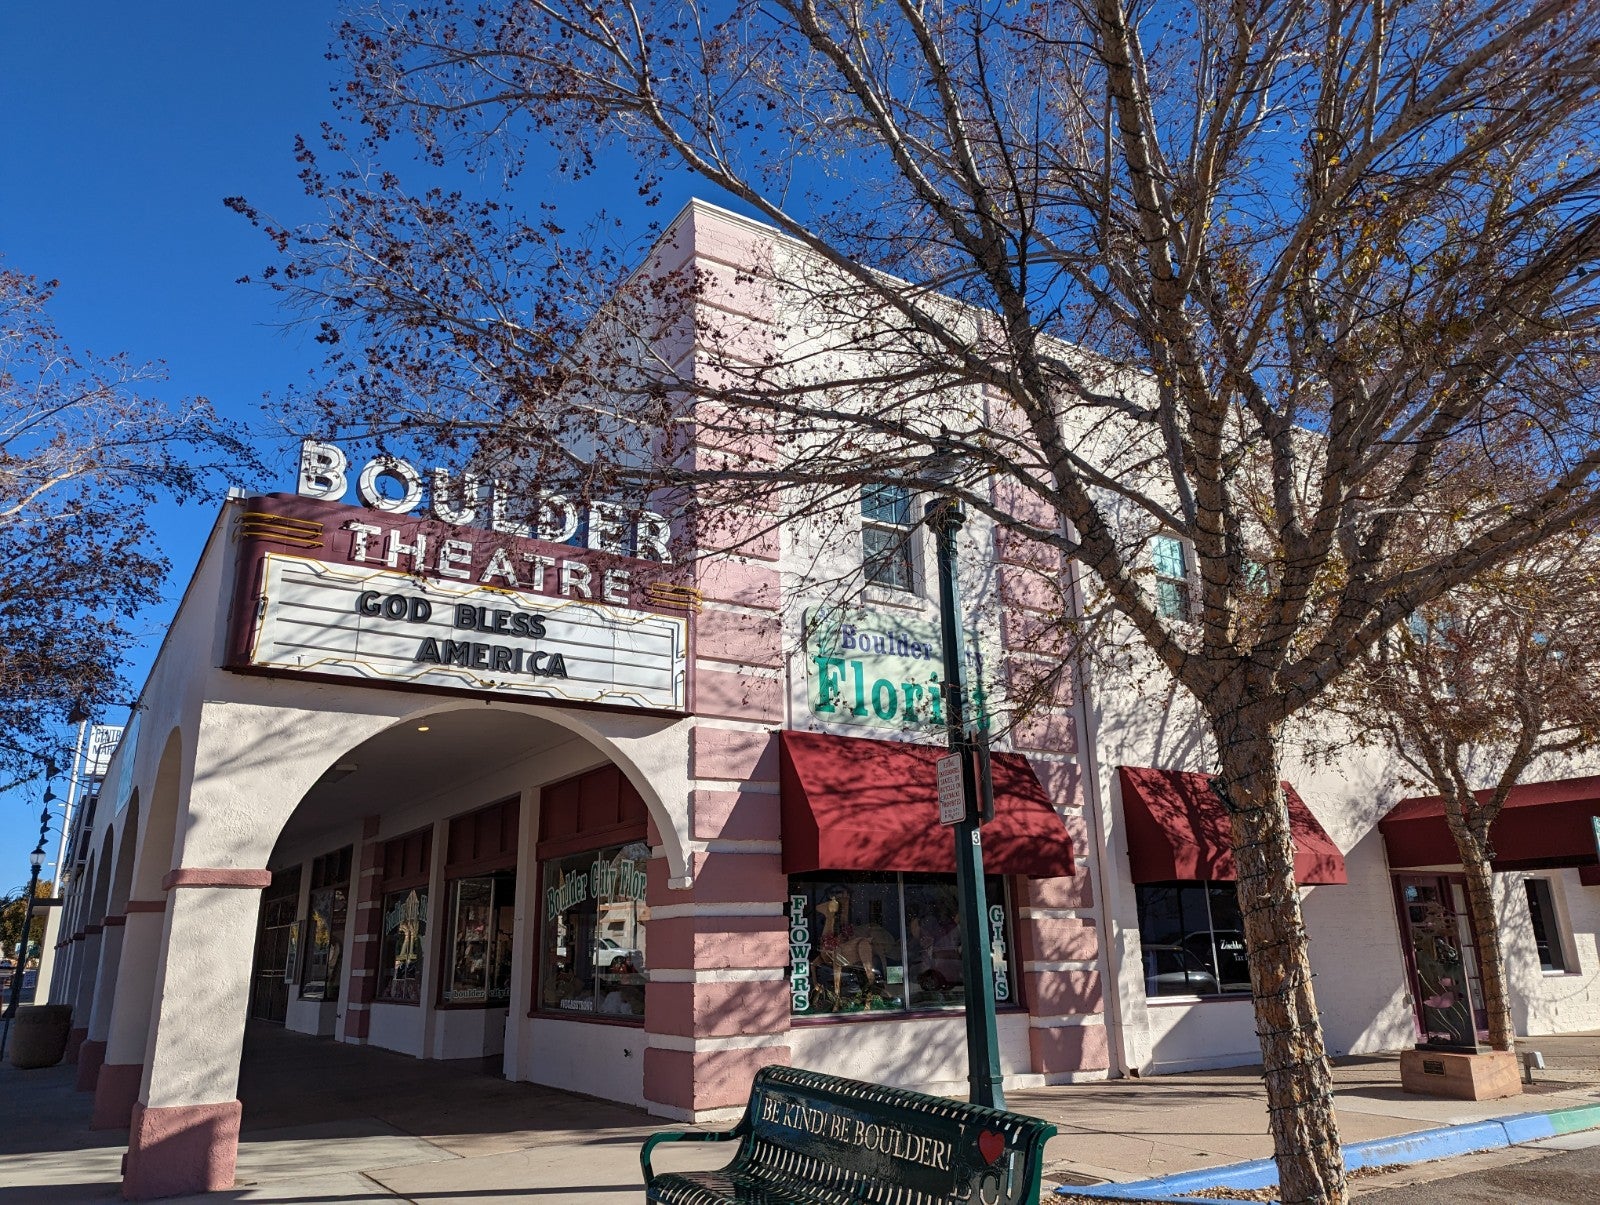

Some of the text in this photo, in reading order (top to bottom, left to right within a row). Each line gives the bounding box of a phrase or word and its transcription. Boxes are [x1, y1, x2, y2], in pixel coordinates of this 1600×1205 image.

[297, 439, 673, 563] BOULDER
[344, 522, 631, 606] THEATRE
[355, 589, 547, 640] GOD BLESS
[841, 624, 933, 661] Boulder
[413, 637, 568, 680] AMERICA
[813, 655, 990, 731] Florit
[973, 833, 979, 844] 3
[547, 867, 588, 921] Boulder
[590, 859, 617, 903] City
[790, 895, 811, 1011] FLOWERS
[989, 905, 1009, 1000] GIFTS
[762, 1098, 952, 1172] BE KIND! BE BOULDER!
